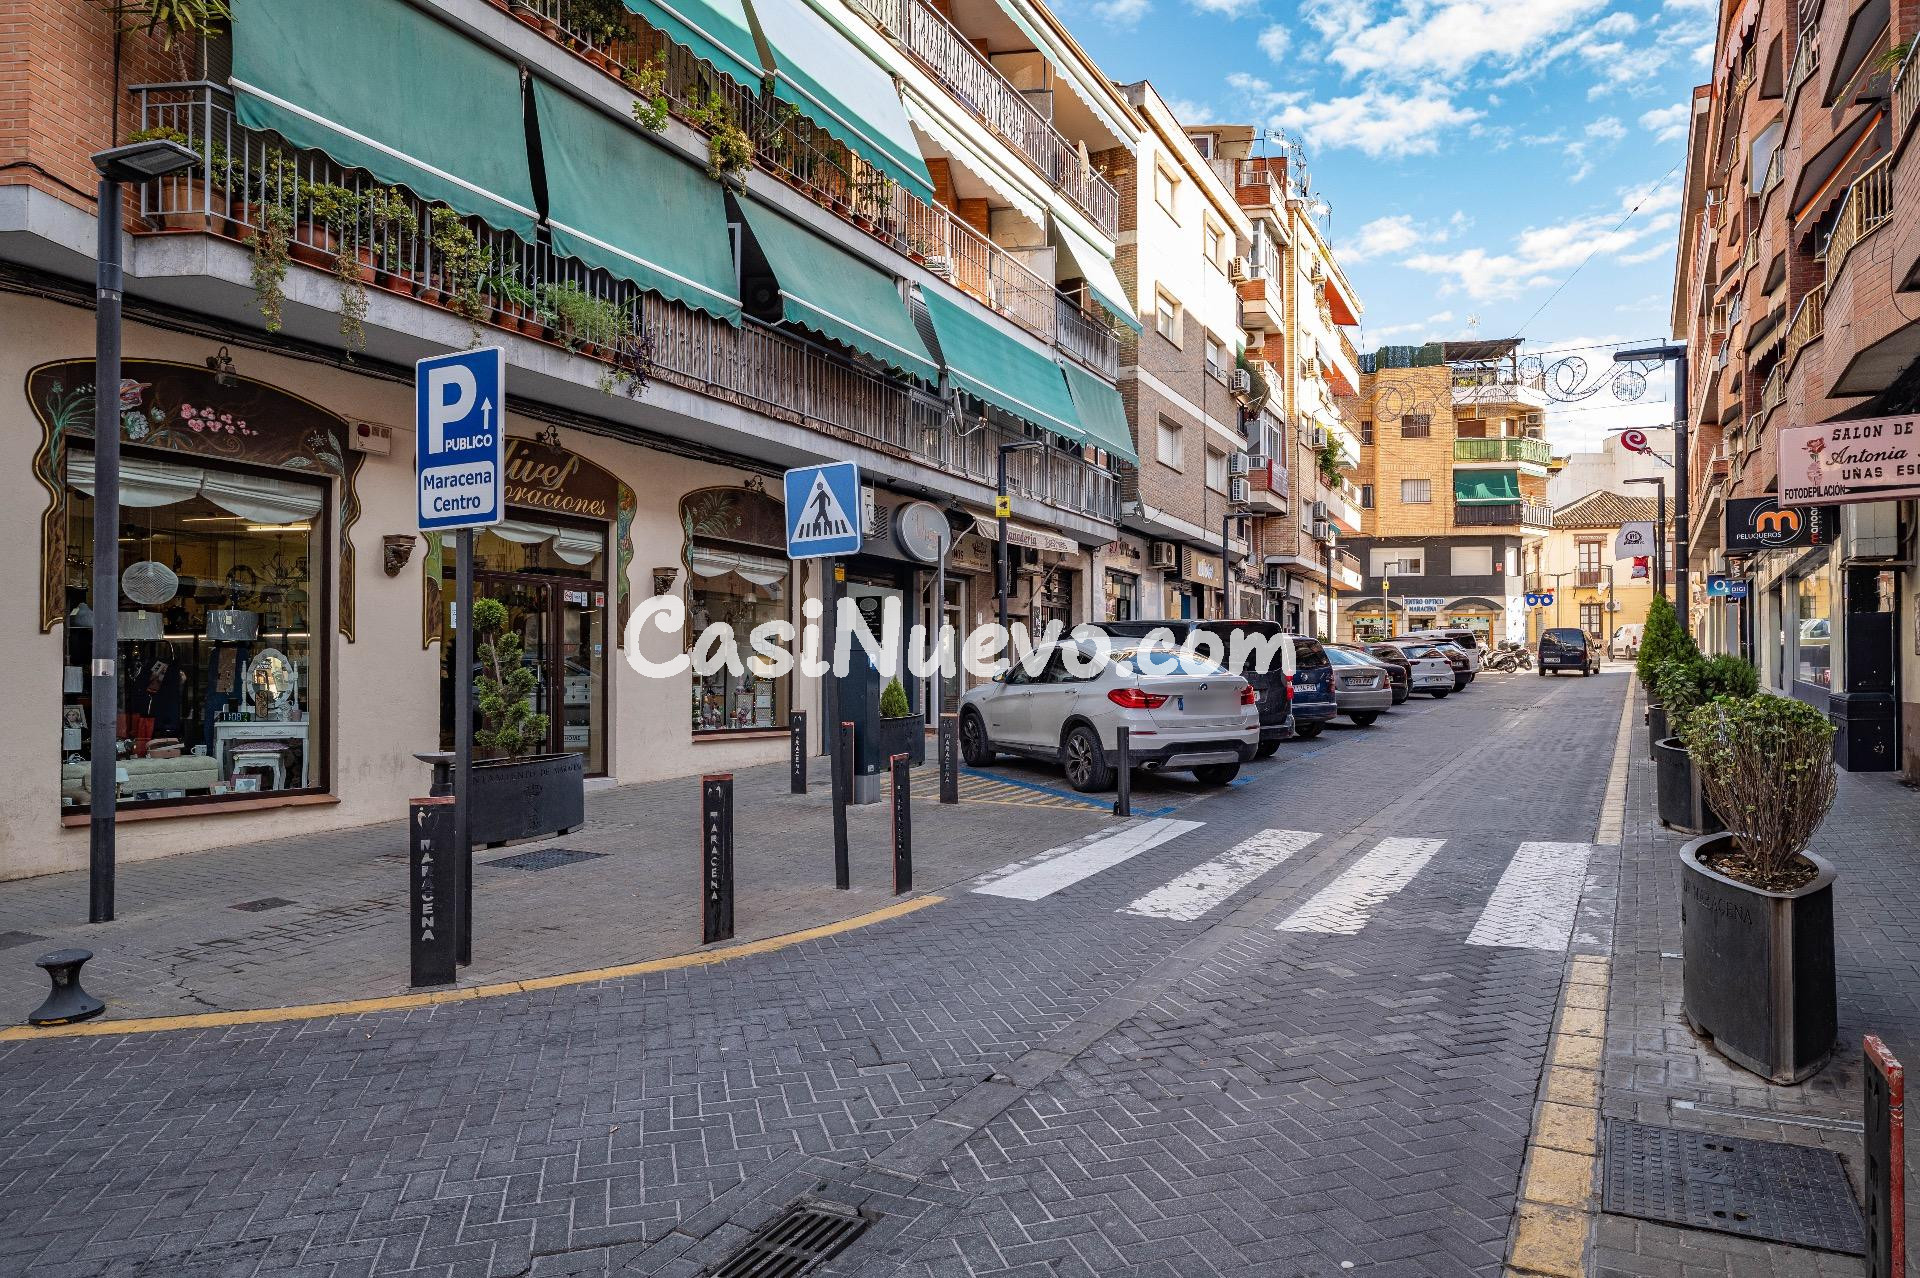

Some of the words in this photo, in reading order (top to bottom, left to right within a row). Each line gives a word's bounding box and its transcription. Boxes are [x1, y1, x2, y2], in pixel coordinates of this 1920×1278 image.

[428, 364, 477, 455] P
[1832, 424, 1883, 441] SALON
[1894, 422, 1914, 435] DE
[445, 433, 493, 453] PUBLICO
[1826, 445, 1909, 466] Antonia
[423, 470, 492, 491] Maracena
[1842, 467, 1883, 480] UÑAS
[1784, 482, 1847, 500] FOTODEPILACIÓN
[433, 494, 481, 512] Centro
[1736, 532, 1782, 540] PELUQUEROS
